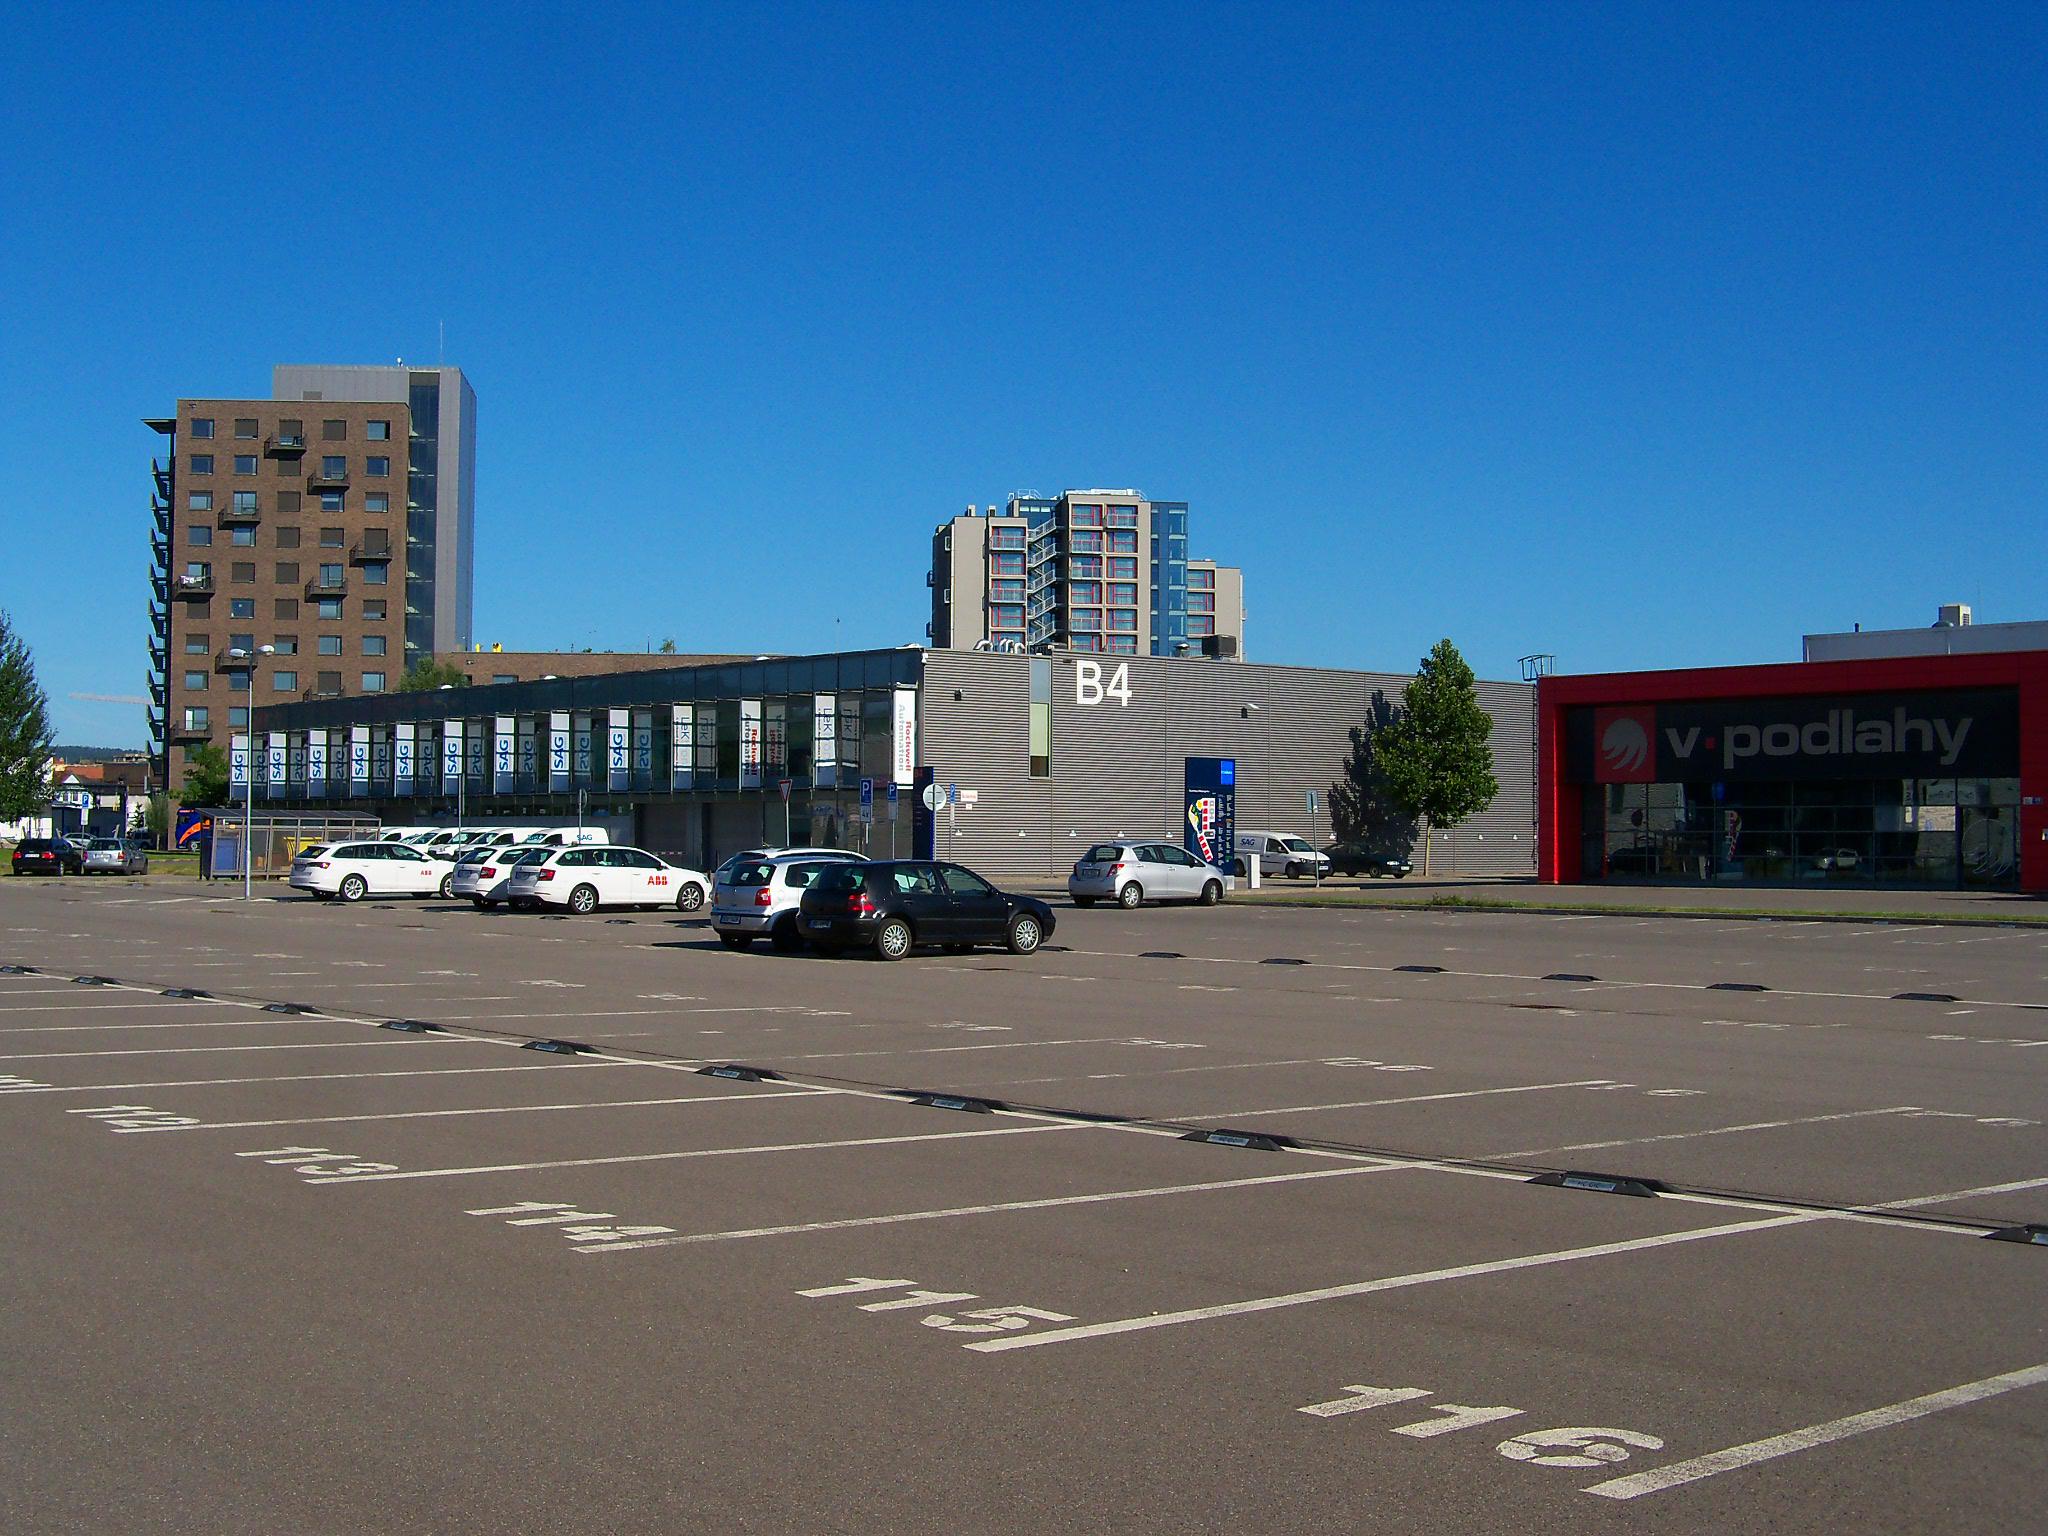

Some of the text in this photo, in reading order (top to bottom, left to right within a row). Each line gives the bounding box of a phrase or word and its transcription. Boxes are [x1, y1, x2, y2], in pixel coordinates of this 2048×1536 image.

[1075, 659, 1133, 707] B4
[554, 736, 564, 769] SAG
[613, 733, 623, 767] SAG
[898, 704, 906, 771] Automation
[1723, 706, 1973, 770] podlahy
[235, 754, 243, 781] SAG
[272, 751, 282, 779] SAG
[312, 749, 322, 778] SAG
[355, 747, 364, 776] SAG
[400, 745, 409, 775] SAG
[447, 742, 458, 773] SAG
[499, 739, 509, 771] SAG
[862, 781, 870, 797] P
[889, 784, 896, 796] P
[1240, 838, 1256, 846] SAG
[647, 875, 668, 886] ABB
[65, 1105, 201, 1128] 112
[234, 1145, 399, 1177] 113
[464, 1199, 677, 1242] 114
[794, 1276, 1080, 1333] 115
[1296, 1383, 1666, 1468] 116
